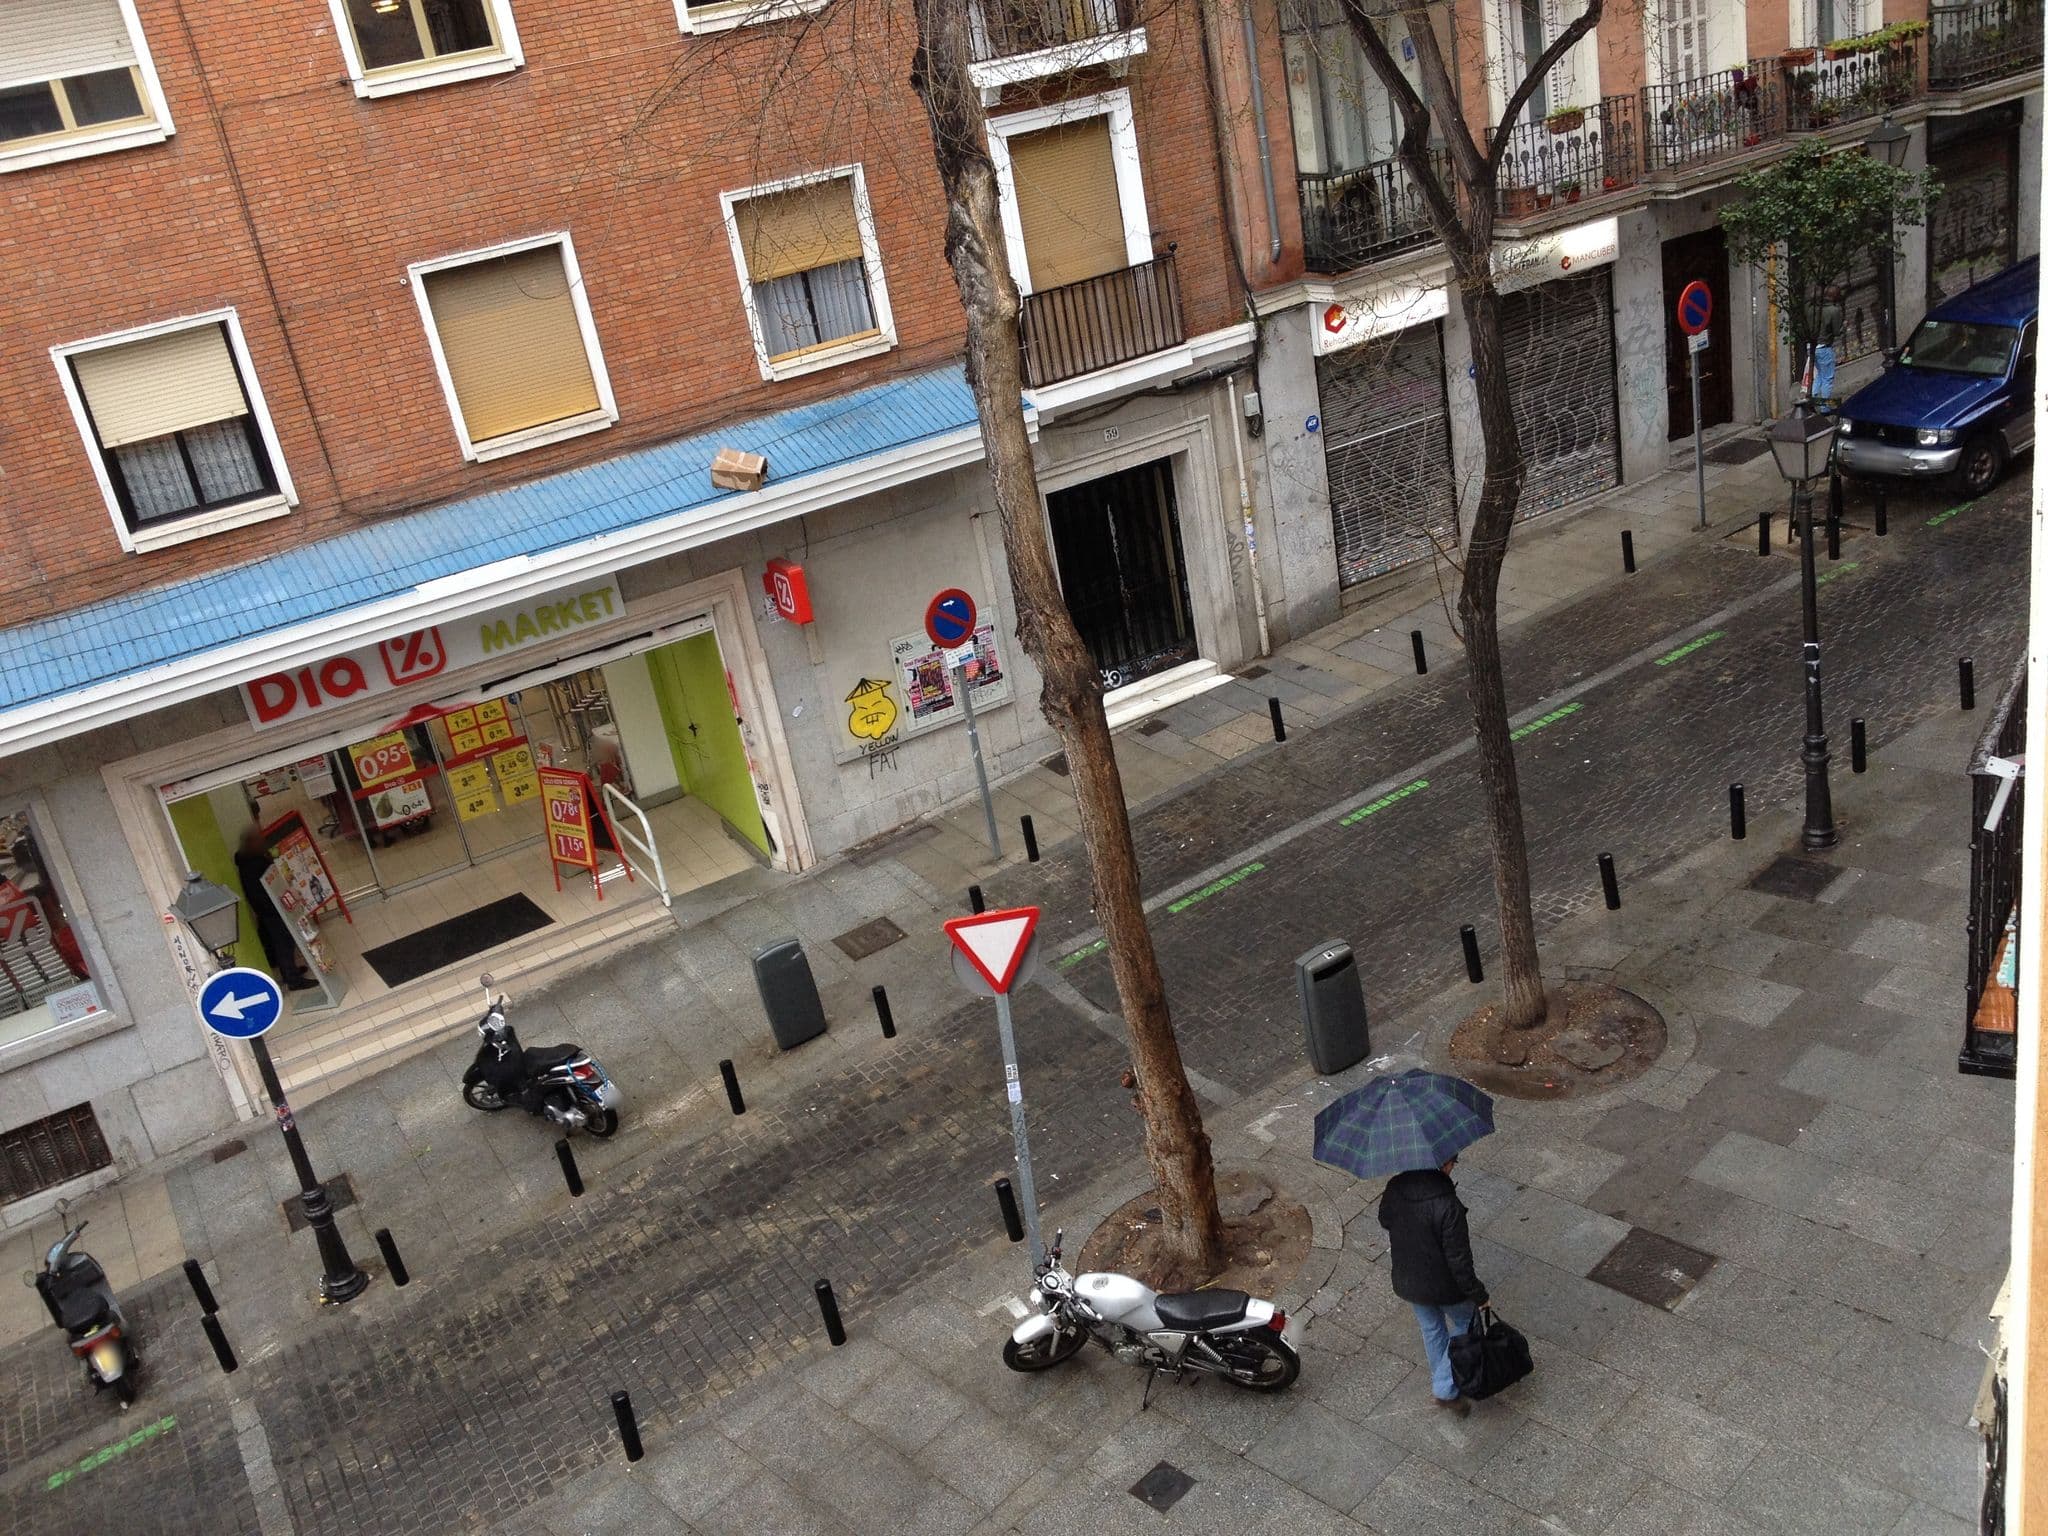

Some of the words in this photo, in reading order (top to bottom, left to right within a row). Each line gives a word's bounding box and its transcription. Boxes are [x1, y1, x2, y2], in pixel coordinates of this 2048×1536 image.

[480, 585, 615, 654] MARKET
[858, 727, 899, 756] YELLOW
[869, 746, 900, 780] FAT
